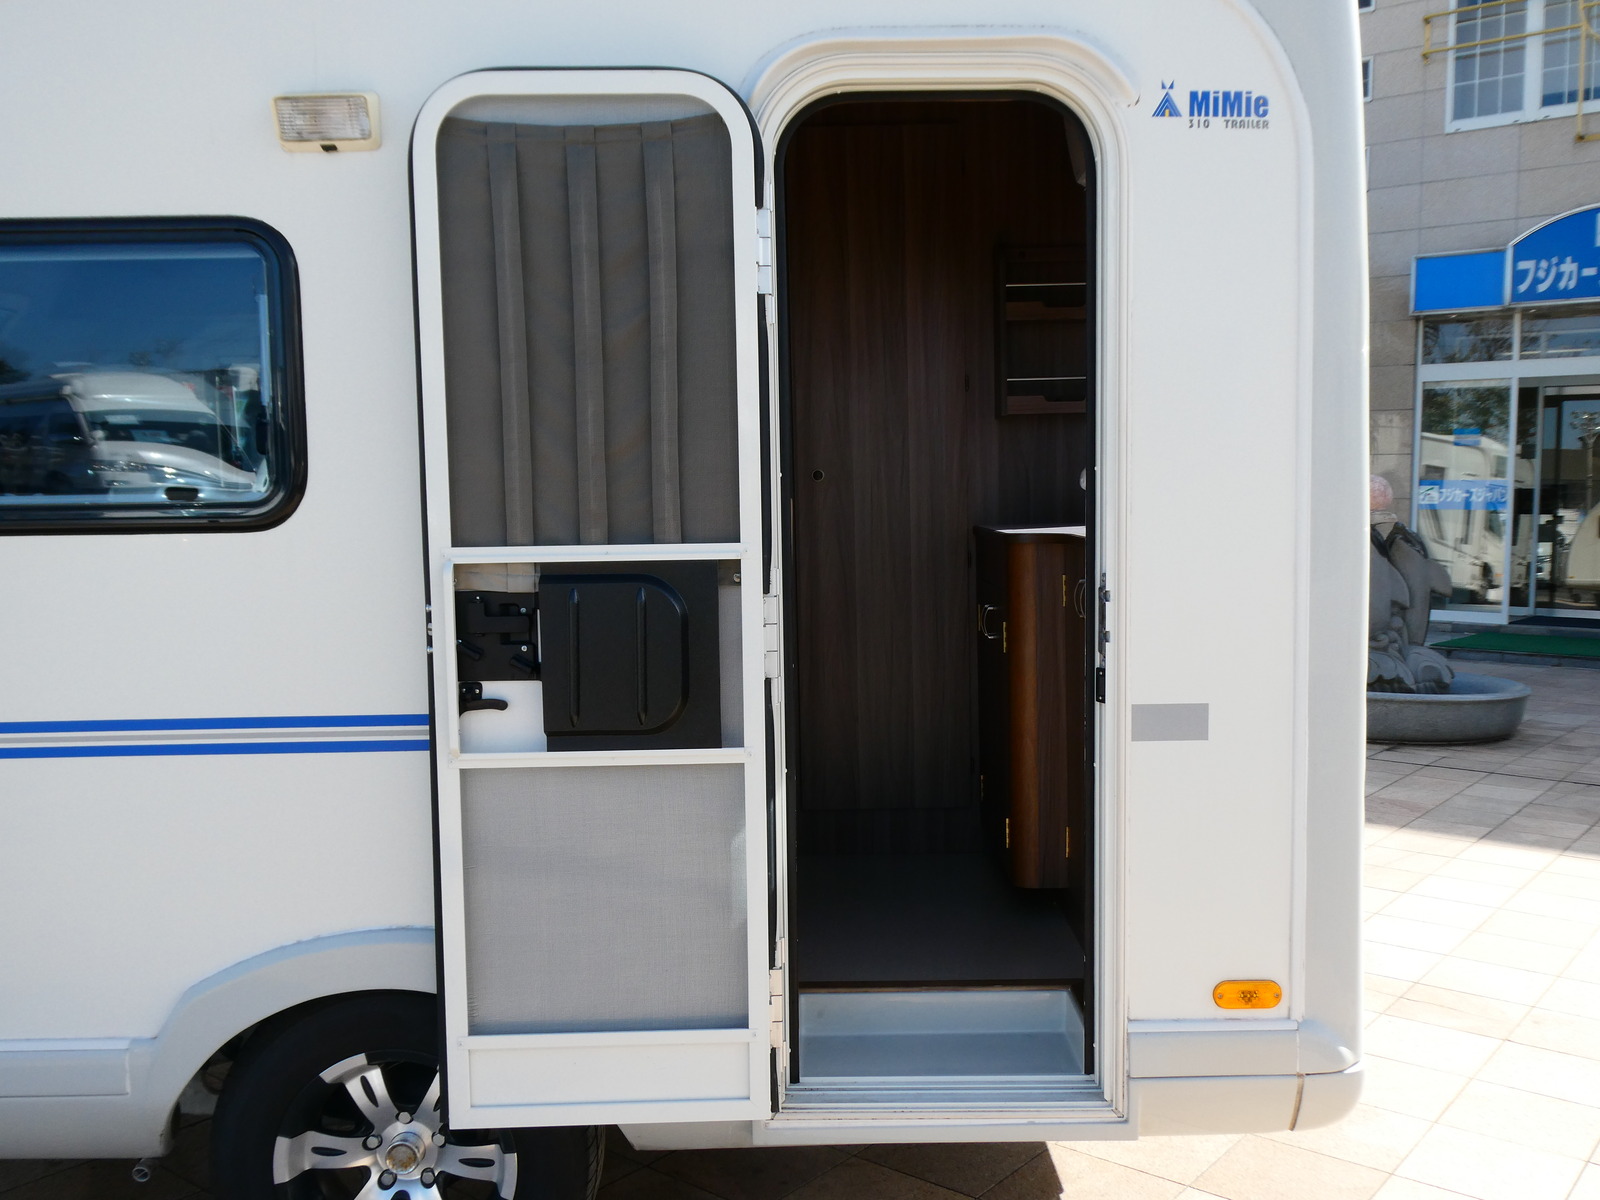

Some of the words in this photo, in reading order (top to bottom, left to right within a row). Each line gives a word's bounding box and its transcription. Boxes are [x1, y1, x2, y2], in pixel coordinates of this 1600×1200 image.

[1189, 90, 1269, 118] MiMie
[1223, 118, 1269, 129] TRAILER
[1516, 255, 1600, 293] フジカー
